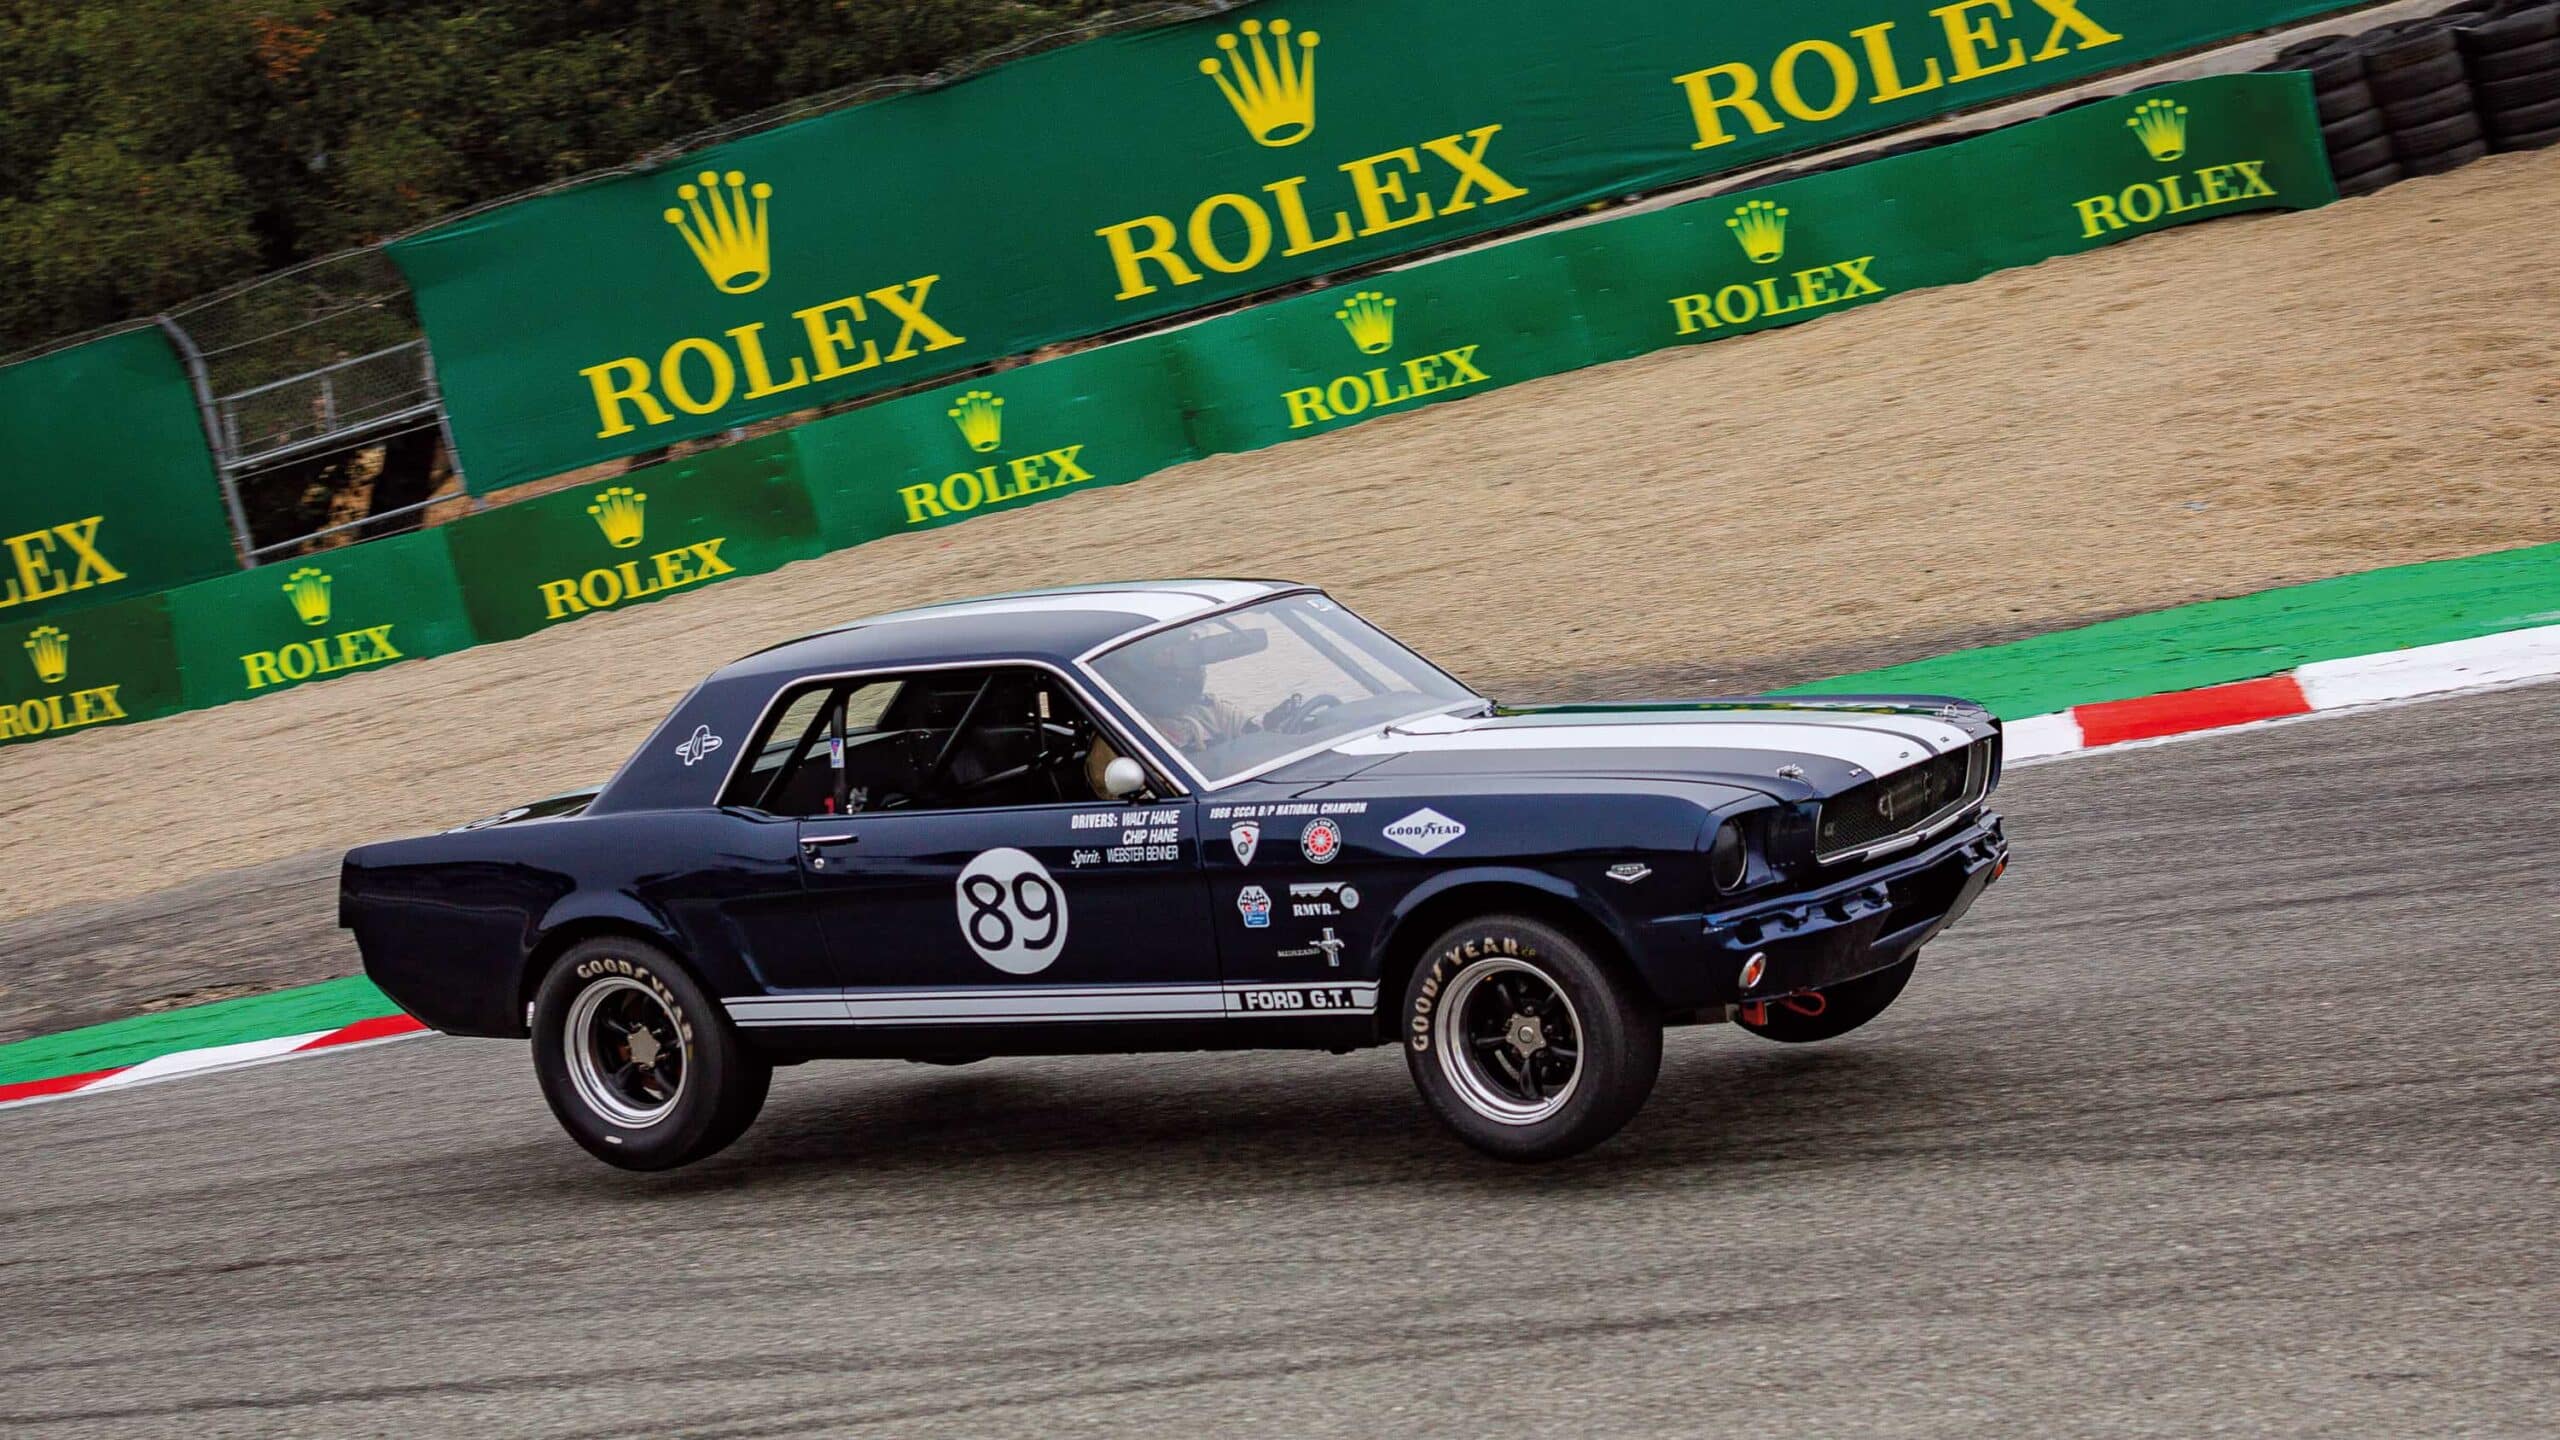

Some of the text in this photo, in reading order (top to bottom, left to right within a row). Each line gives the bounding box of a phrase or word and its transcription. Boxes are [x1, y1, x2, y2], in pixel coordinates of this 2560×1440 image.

[1674, 0, 2124, 150] ROLEX
[1096, 124, 1528, 301] ROLEX
[2075, 161, 2277, 239] ROLEX
[1670, 256, 1883, 337] ROLEX
[579, 274, 965, 439] ROLEX
[1283, 344, 1491, 429] ROLEX
[900, 444, 1092, 524] ROLEX
[539, 537, 736, 620] ROLEX
[241, 624, 404, 690] ROLEX
[0, 684, 128, 740] ROLEX
[1071, 809, 1181, 829] DRIVERS: WALT HANE
[1122, 828, 1179, 845] CHIP HANE
[1232, 805, 1257, 818] SCCA
[1275, 803, 1319, 816] NATIONAL
[1319, 801, 1368, 815] CHAMPION
[1106, 847, 1145, 863] WEBSTER
[962, 871, 1060, 952] 89
[1292, 903, 1332, 917] RMVR
[1245, 989, 1350, 1010] FORD G.T.
[1411, 936, 1519, 1051] GOODYEAR
